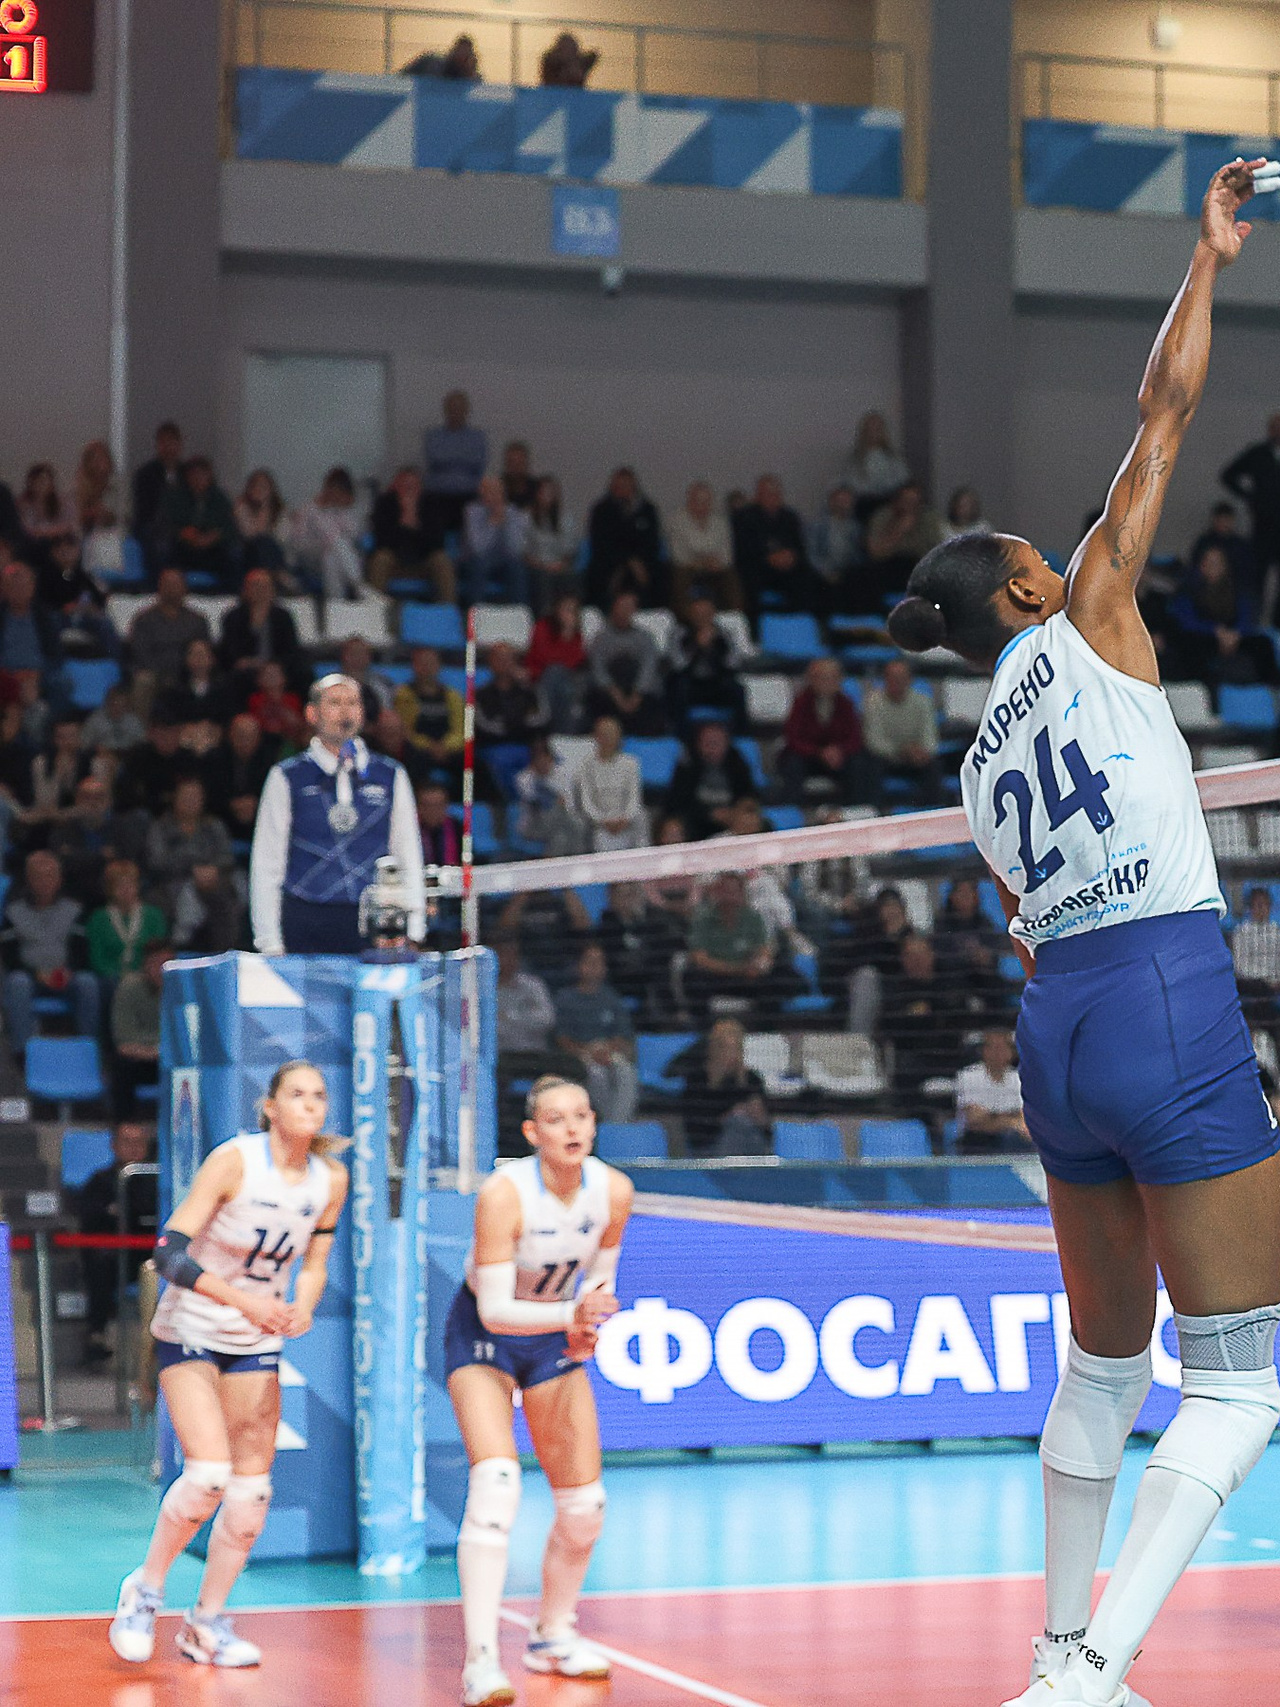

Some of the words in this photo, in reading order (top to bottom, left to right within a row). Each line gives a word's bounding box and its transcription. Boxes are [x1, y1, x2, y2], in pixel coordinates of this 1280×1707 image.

[994, 724, 1115, 894] 24
[245, 1228, 294, 1272] 14
[534, 1259, 579, 1294] 11
